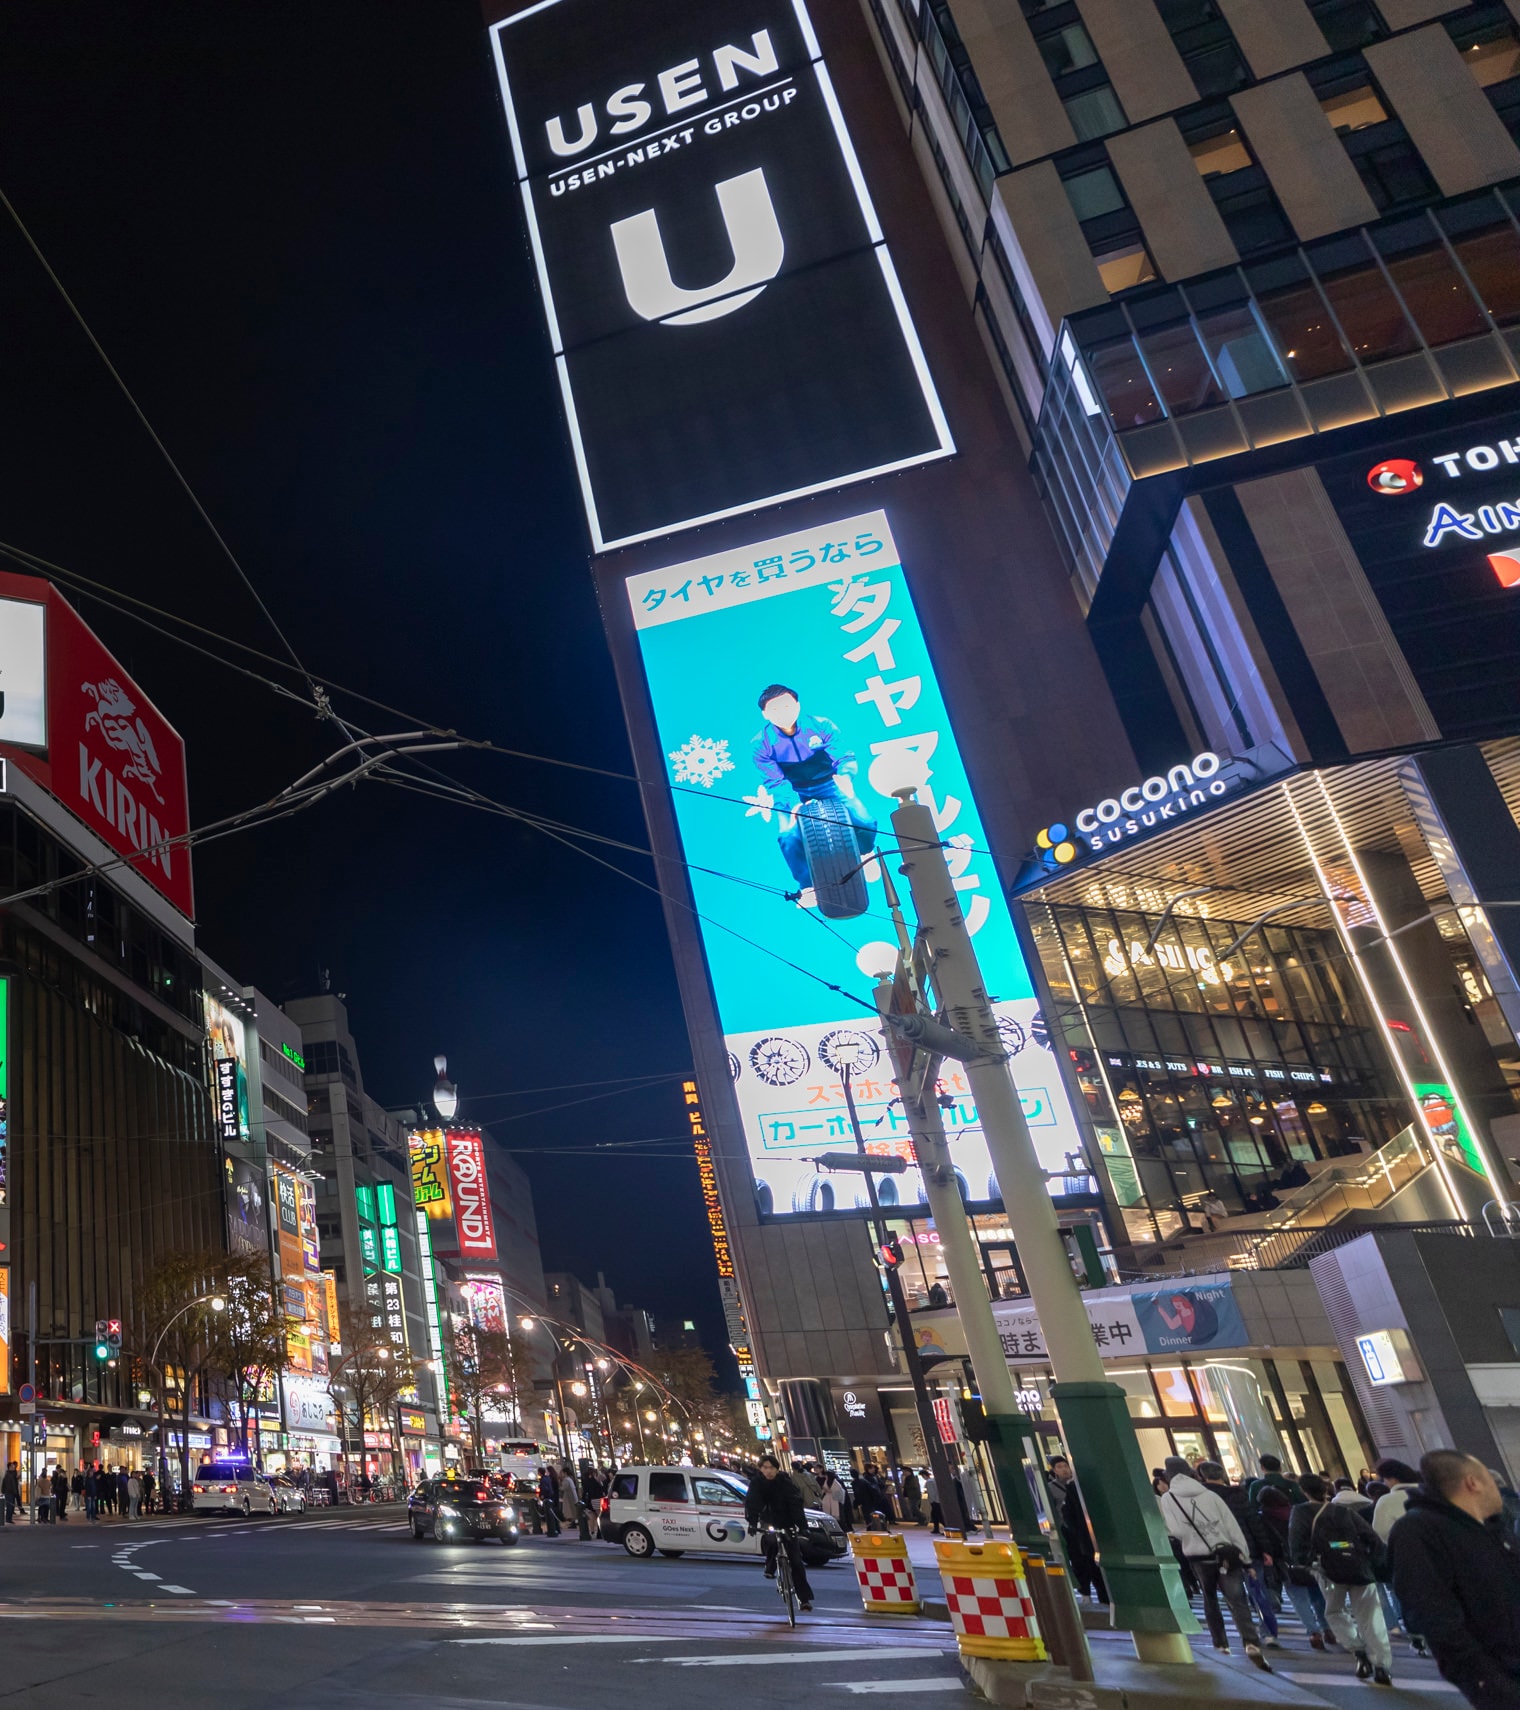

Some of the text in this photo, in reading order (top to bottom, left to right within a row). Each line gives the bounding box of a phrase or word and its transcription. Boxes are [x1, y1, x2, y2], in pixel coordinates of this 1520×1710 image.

[544, 28, 780, 157] USEN
[549, 87, 799, 198] USEN-NEXT GROUP
[641, 532, 884, 612] タイヤを買うなら
[80, 741, 172, 880] KIRIN
[1090, 780, 1226, 850] SUSUKINO
[282, 1206, 296, 1226] CLUB
[451, 1140, 493, 1249] ROUND1
[1195, 1287, 1225, 1301] Night
[1159, 1335, 1193, 1346] Dinner
